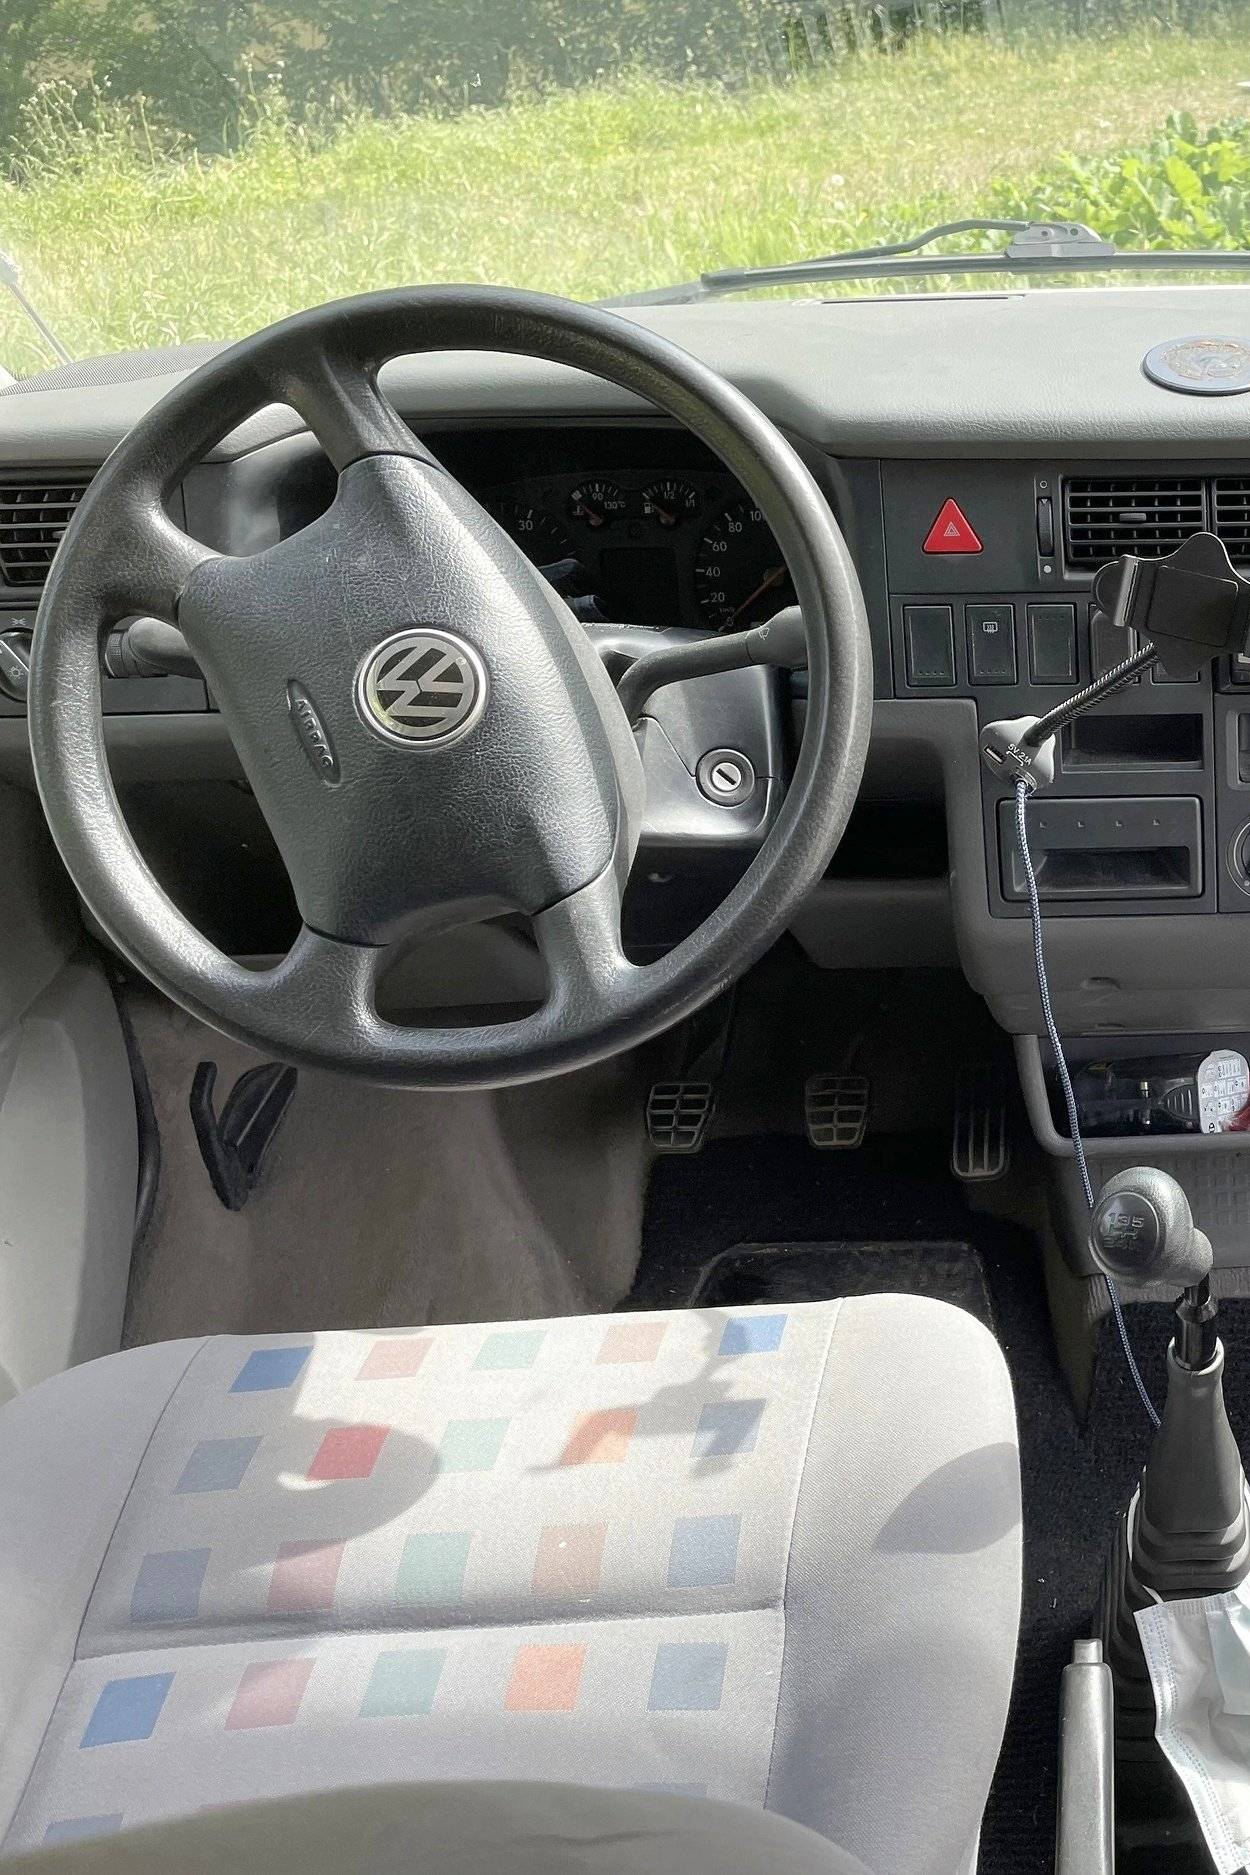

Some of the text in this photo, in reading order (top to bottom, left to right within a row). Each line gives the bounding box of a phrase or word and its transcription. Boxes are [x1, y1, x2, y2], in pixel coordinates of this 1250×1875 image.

[592, 493, 604, 501] 90
[750, 511, 763, 521] 10
[518, 520, 533, 531] 30
[728, 522, 742, 533] 80
[712, 541, 728, 552] 60
[705, 566, 721, 577] 40
[710, 592, 725, 602] 20
